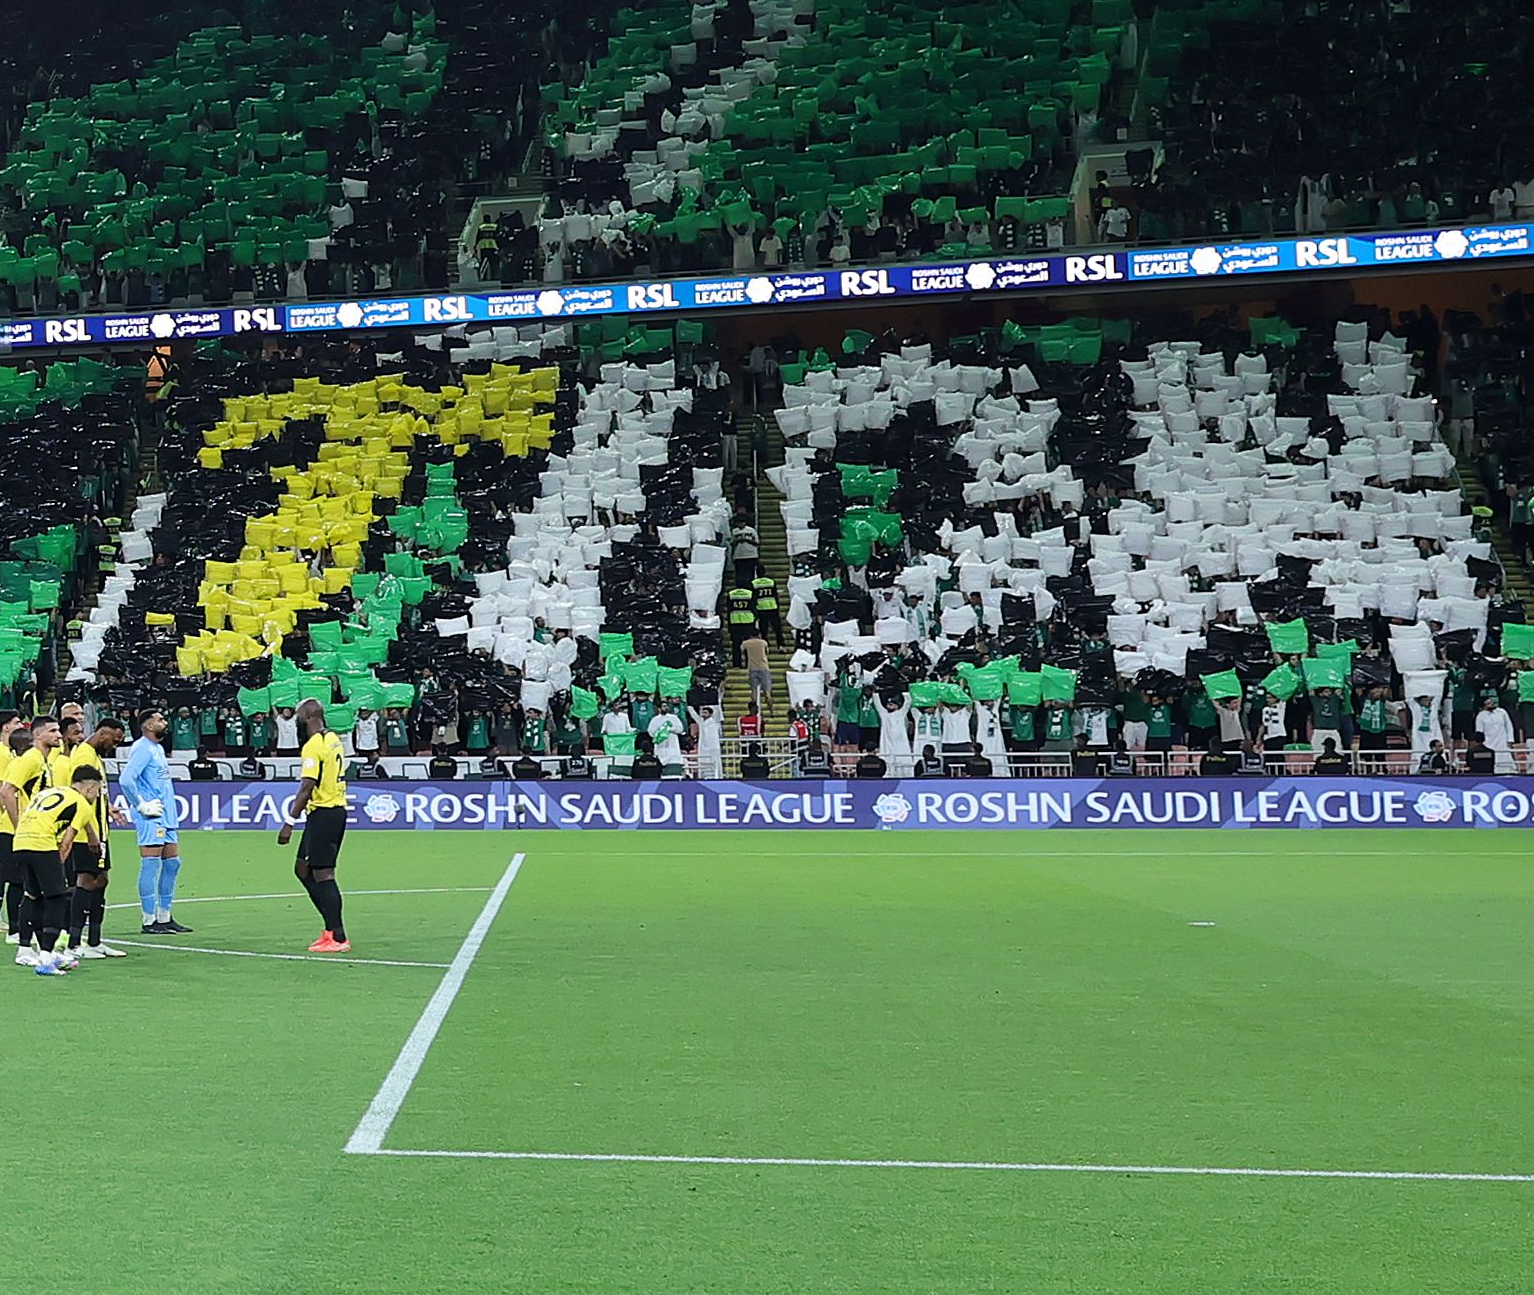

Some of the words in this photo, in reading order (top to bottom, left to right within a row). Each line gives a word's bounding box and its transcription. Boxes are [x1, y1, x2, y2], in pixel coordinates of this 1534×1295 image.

[1295, 236, 1357, 267] RSL
[1375, 242, 1435, 260] LEAGUE
[1065, 253, 1123, 282] RSL
[1133, 259, 1191, 277] LEAGUE
[627, 282, 679, 309] RSL
[840, 269, 895, 297] RSL
[912, 275, 966, 291] LEAGUE
[423, 295, 473, 321] RSL
[488, 301, 537, 316] LEAGUE
[694, 288, 746, 304] LEAGUE
[45, 318, 91, 343] RSL
[105, 324, 151, 338] LEAGUE
[233, 307, 281, 332] RSL
[290, 313, 338, 328] LEAGUE
[405, 793, 546, 822] ROSHN
[560, 794, 683, 823] SAUDI
[696, 793, 854, 822] LEAGUE
[918, 792, 1071, 822] ROSHN
[1086, 791, 1220, 822] SAUDI
[1234, 791, 1406, 821] LEAGUE
